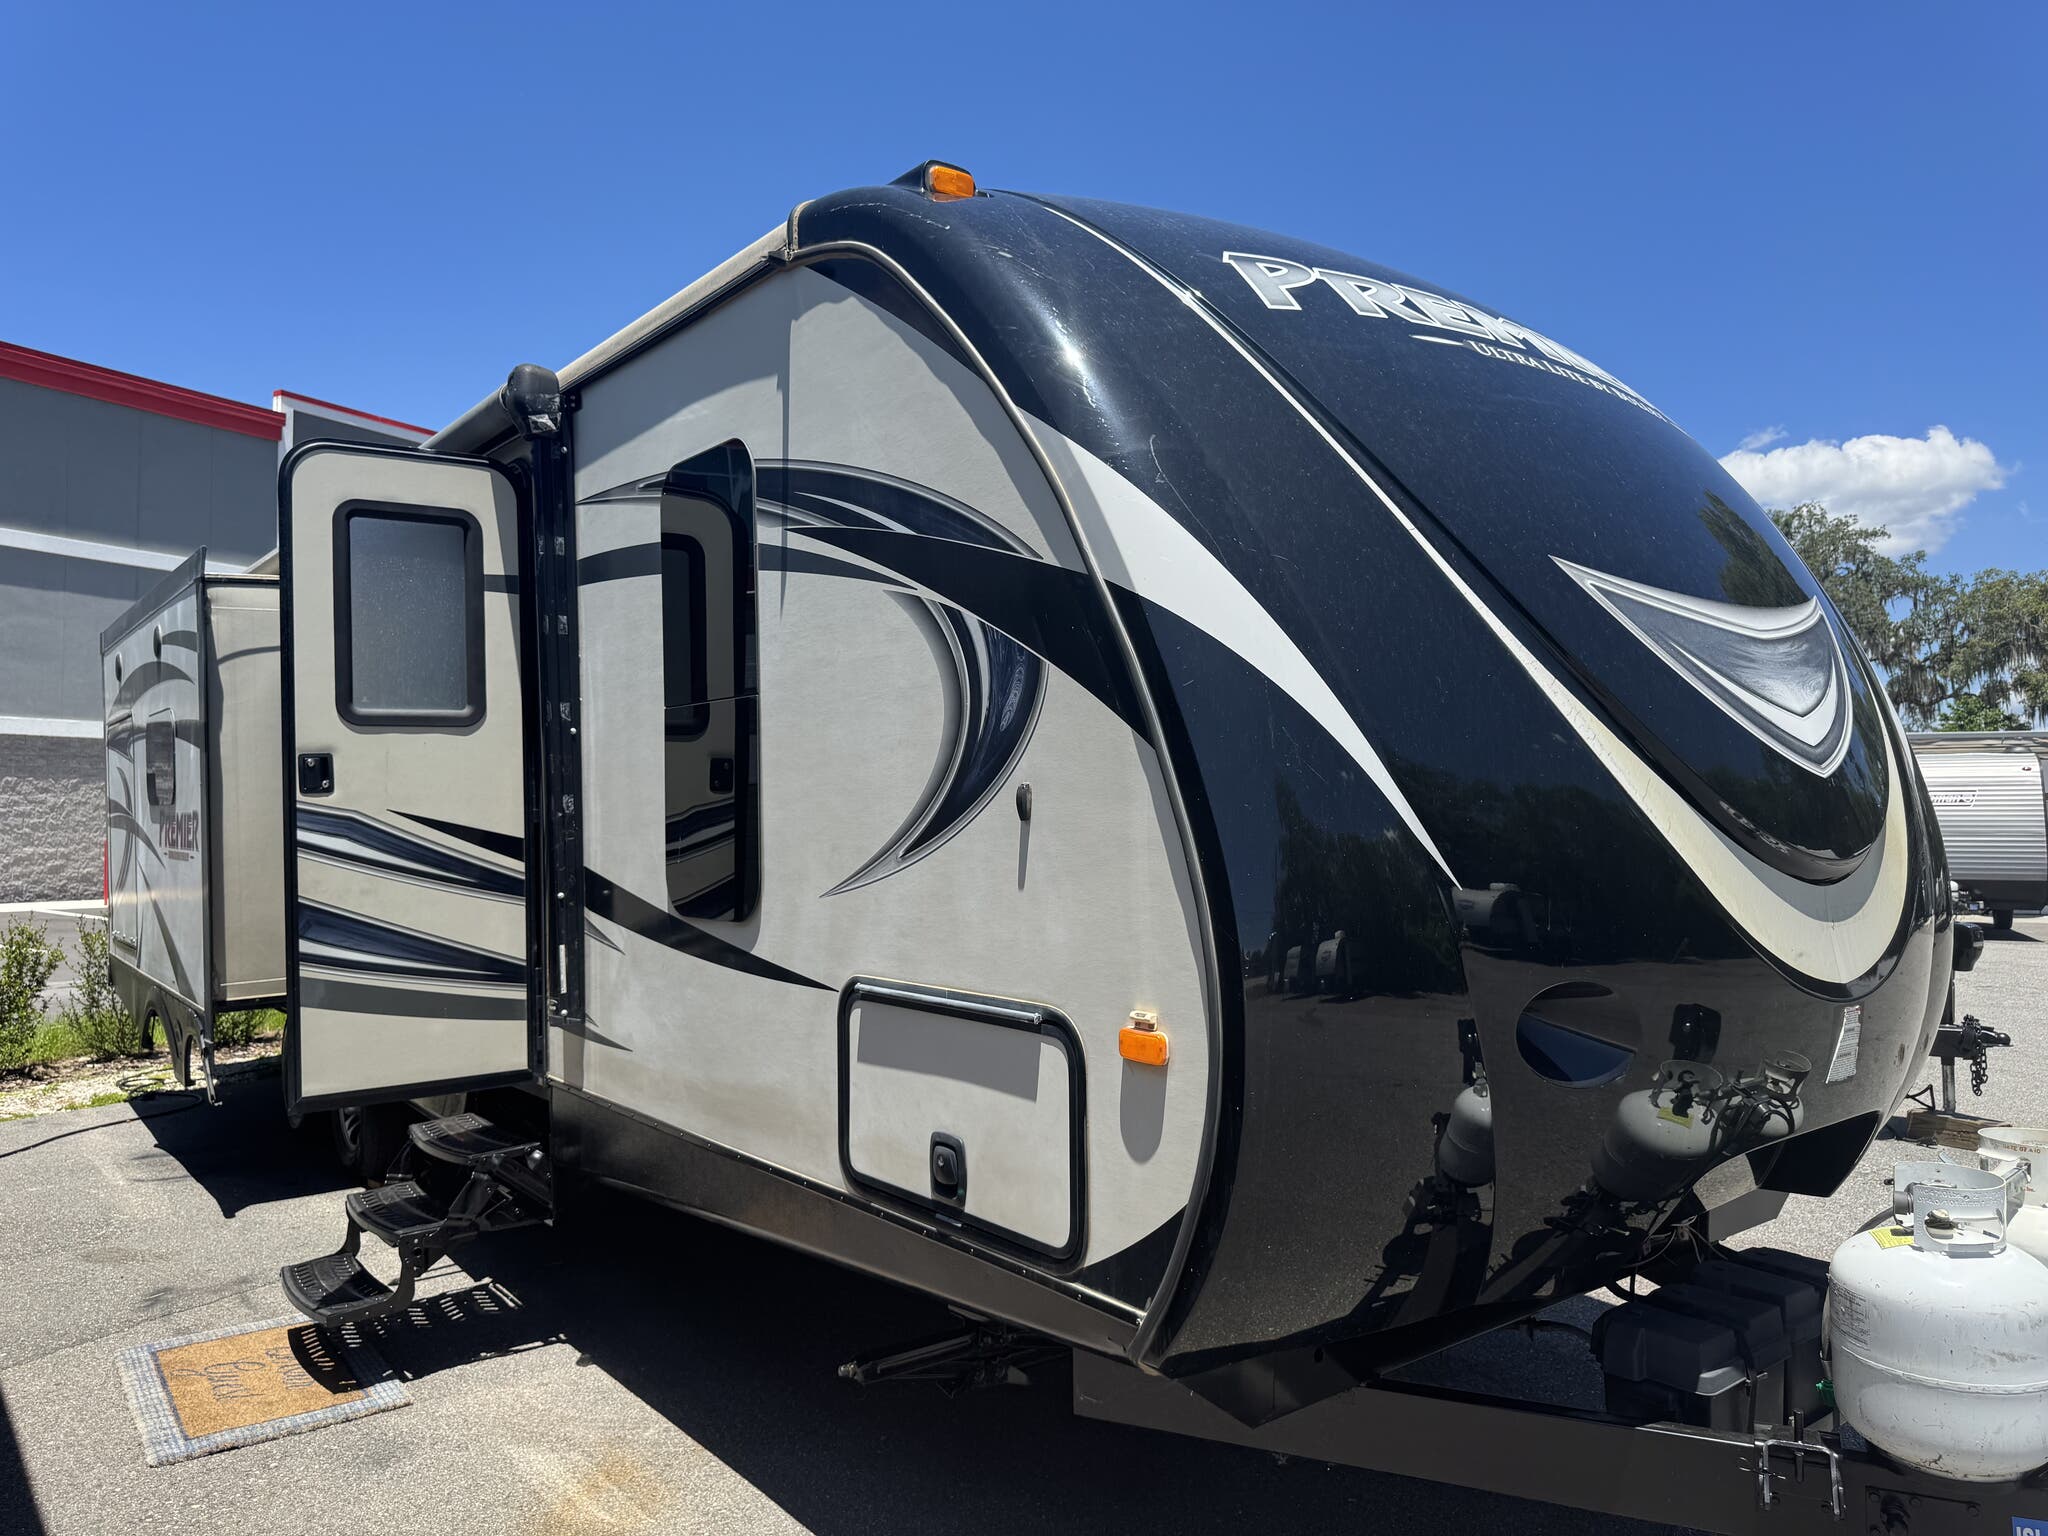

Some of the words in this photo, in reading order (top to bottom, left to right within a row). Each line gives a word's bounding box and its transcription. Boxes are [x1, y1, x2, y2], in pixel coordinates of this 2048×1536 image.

[1466, 340, 1545, 370] ULTRA
[1541, 360, 1589, 385] LITE
[159, 810, 200, 852] PREMIER
